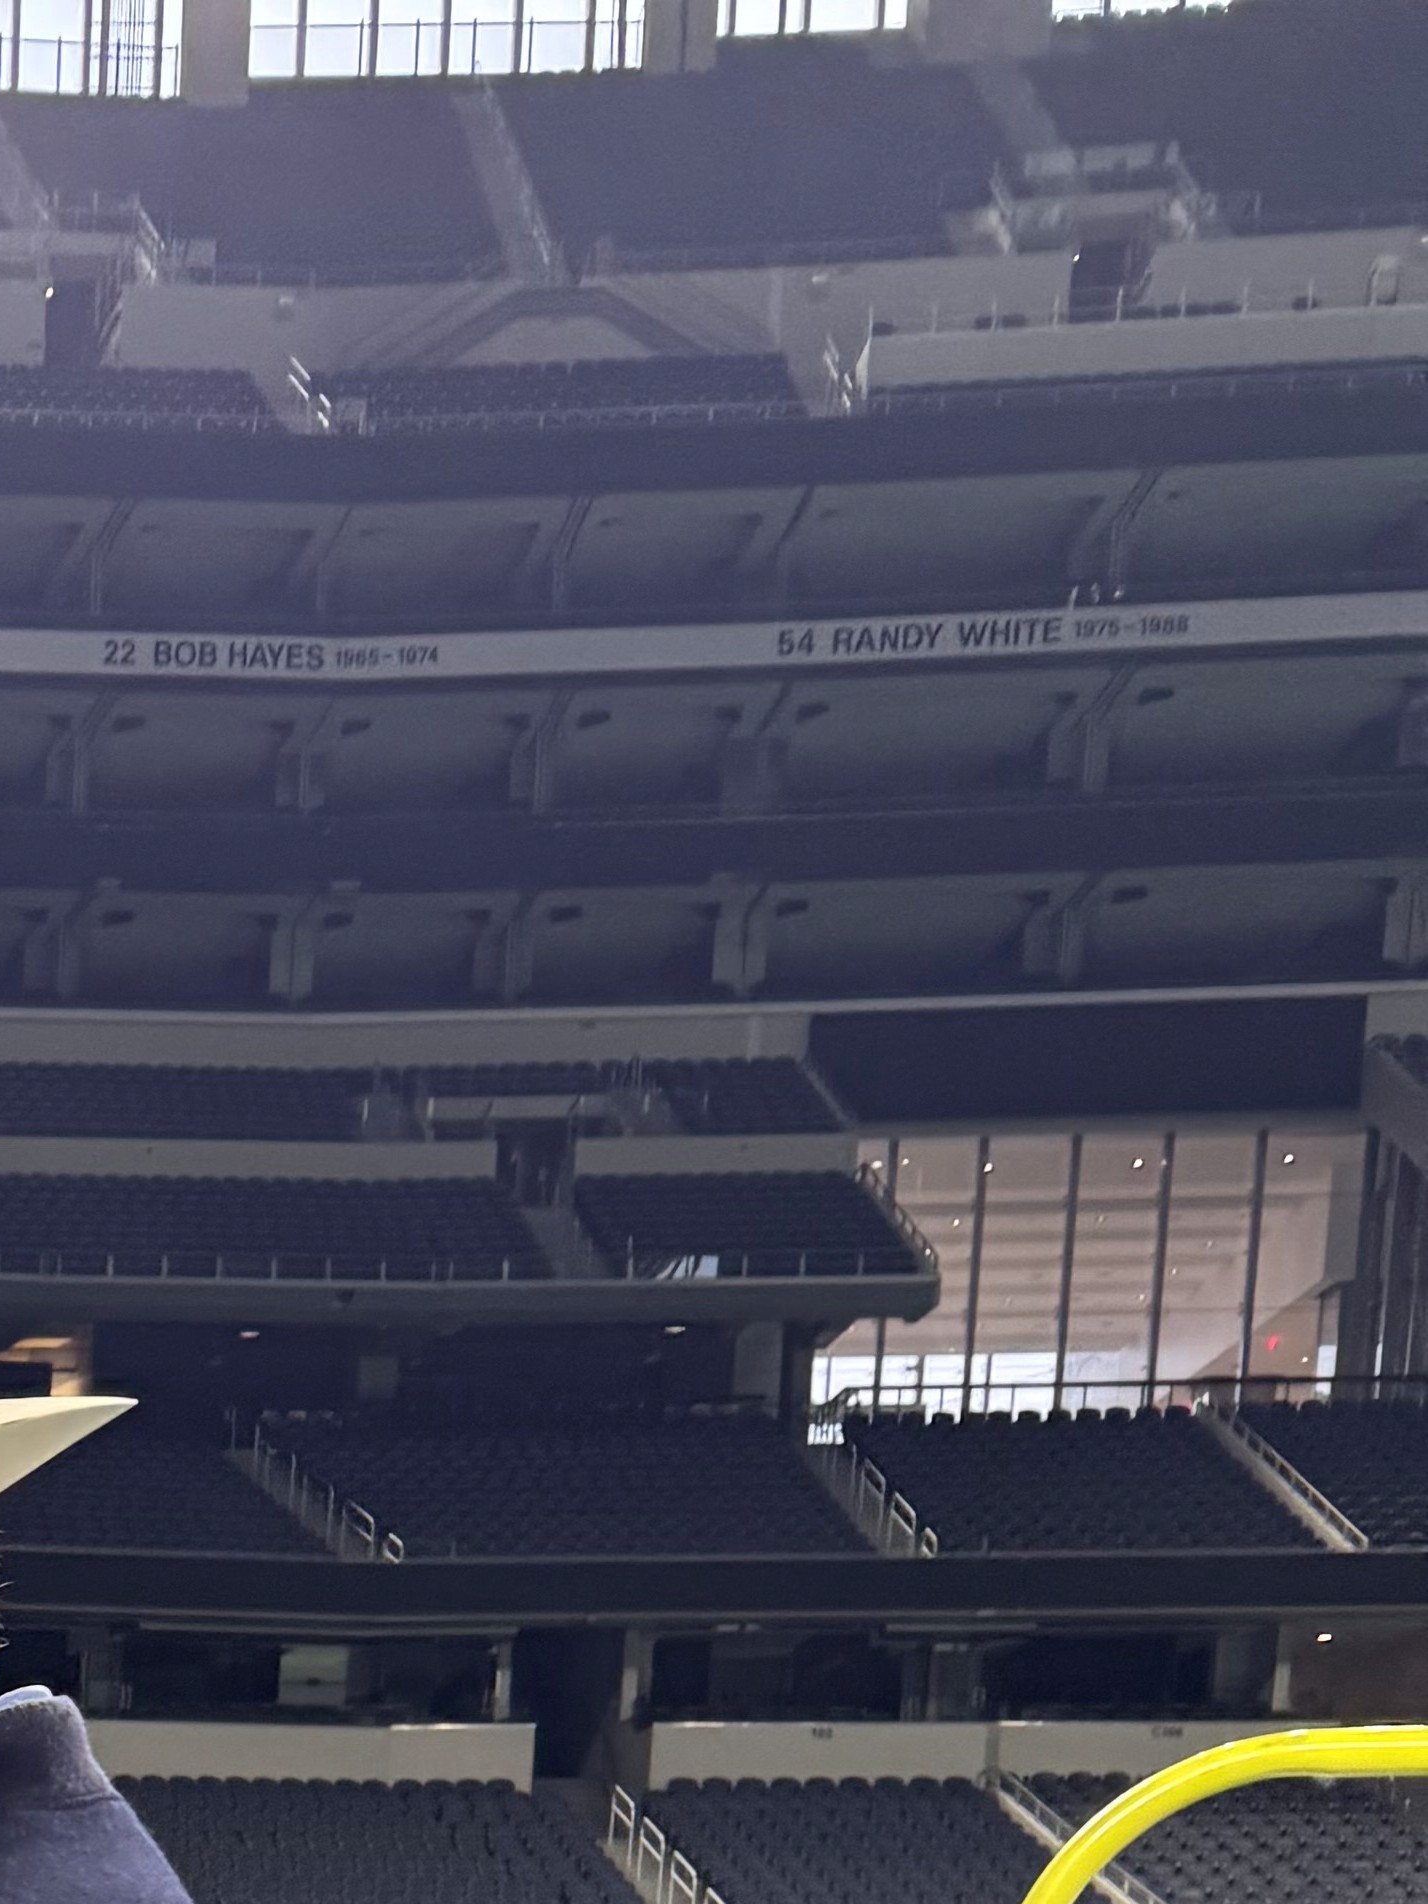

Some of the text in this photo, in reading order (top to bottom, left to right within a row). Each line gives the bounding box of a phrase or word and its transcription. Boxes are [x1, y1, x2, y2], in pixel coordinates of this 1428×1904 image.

[777, 628, 815, 656] 54
[832, 622, 944, 655] RANDY
[958, 616, 1064, 648] WHITE
[104, 638, 137, 667] 22
[153, 639, 218, 668] BOB
[228, 641, 325, 671] HAYES
